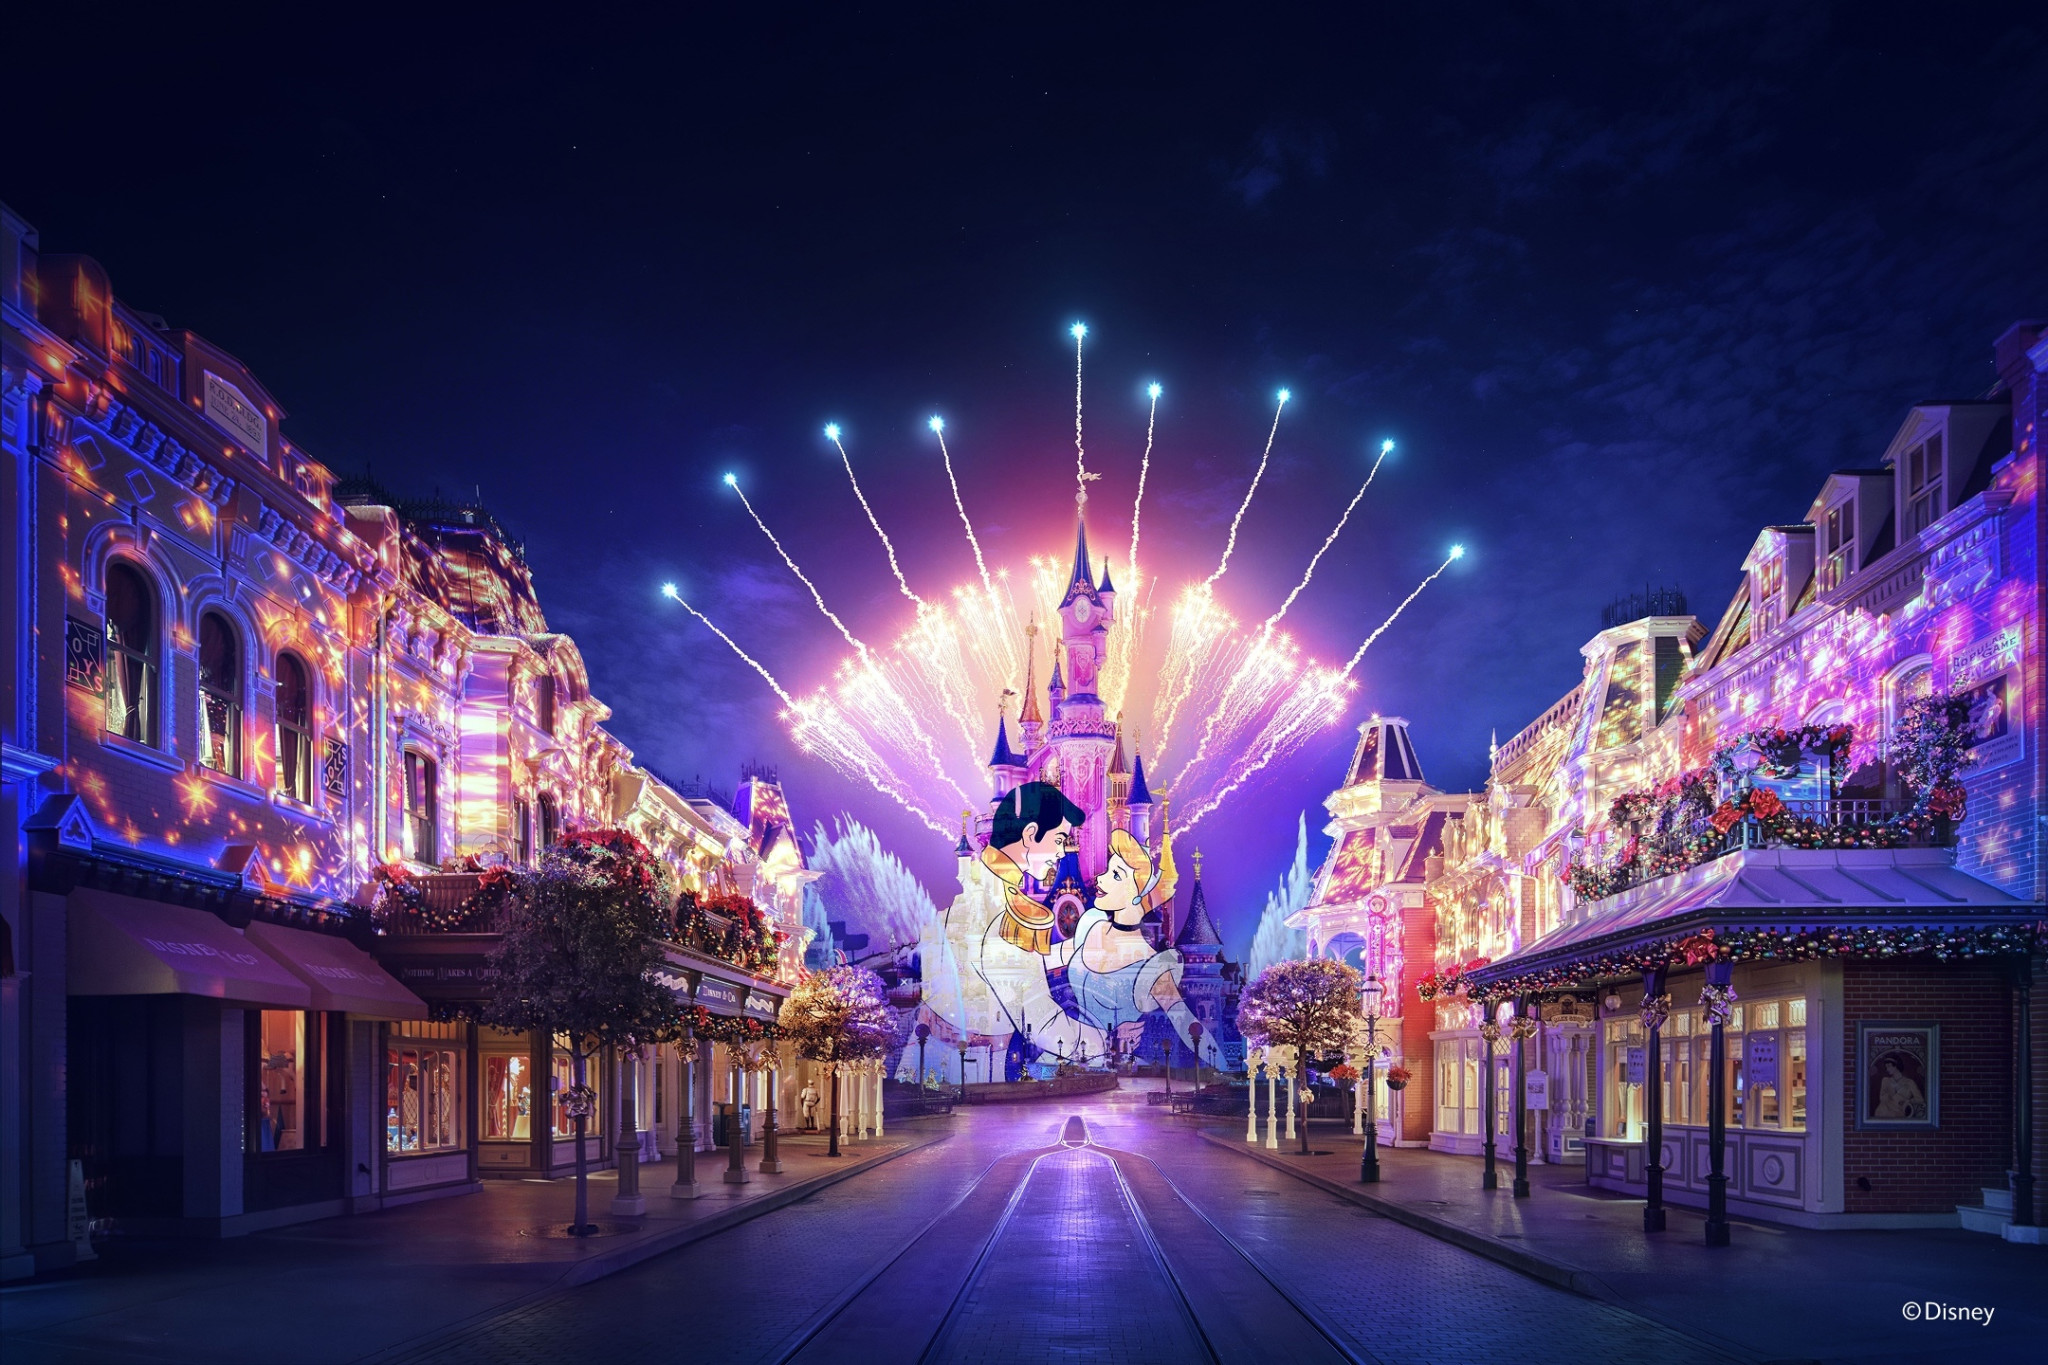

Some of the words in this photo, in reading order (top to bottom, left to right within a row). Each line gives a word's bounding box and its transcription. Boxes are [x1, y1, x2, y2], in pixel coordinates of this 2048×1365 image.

[1953, 633, 2006, 672] POPULAR
[1981, 636, 2017, 658] GAME
[323, 747, 346, 787] DOLLS
[467, 969, 473, 977] A
[1874, 1036, 1920, 1045] PANDORA
